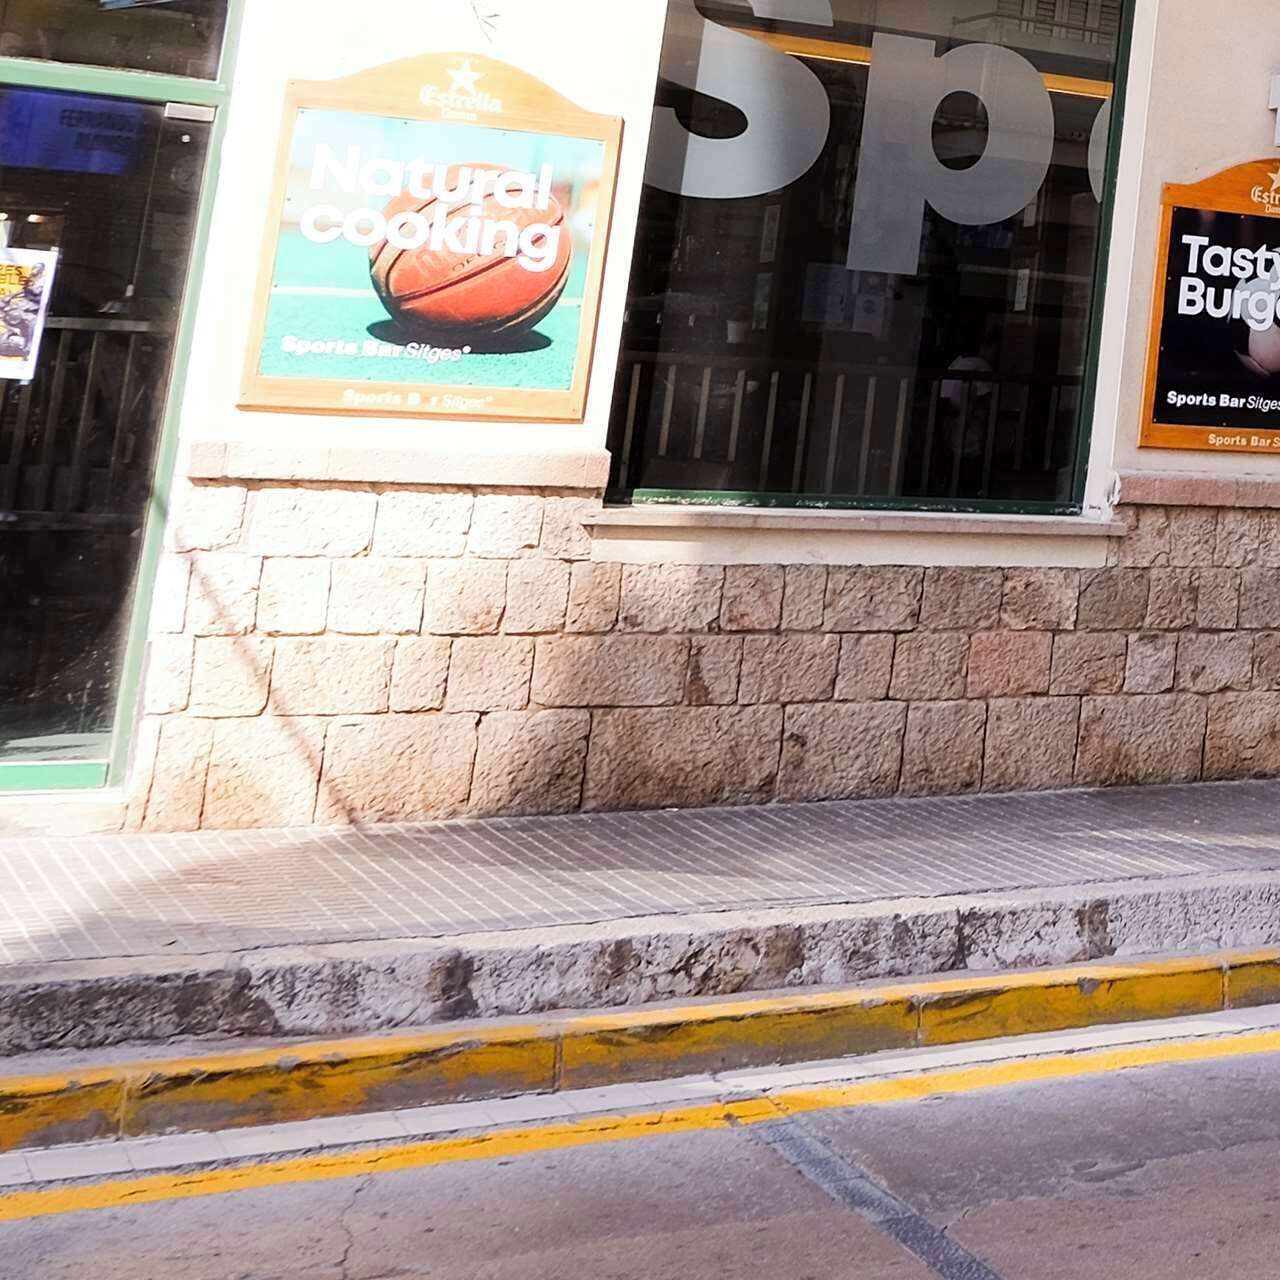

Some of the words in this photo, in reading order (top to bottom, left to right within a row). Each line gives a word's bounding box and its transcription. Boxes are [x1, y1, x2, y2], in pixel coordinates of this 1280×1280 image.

[419, 84, 503, 112] Estrella
[308, 143, 552, 209] Natural
[281, 335, 357, 356] Sports
[343, 389, 401, 405] Sports
[406, 392, 438, 407] Br
[1167, 391, 1217, 407] Sports
[1219, 394, 1247, 408] Bar
[1208, 434, 1247, 447] Sports
[1251, 435, 1271, 447] Bar
